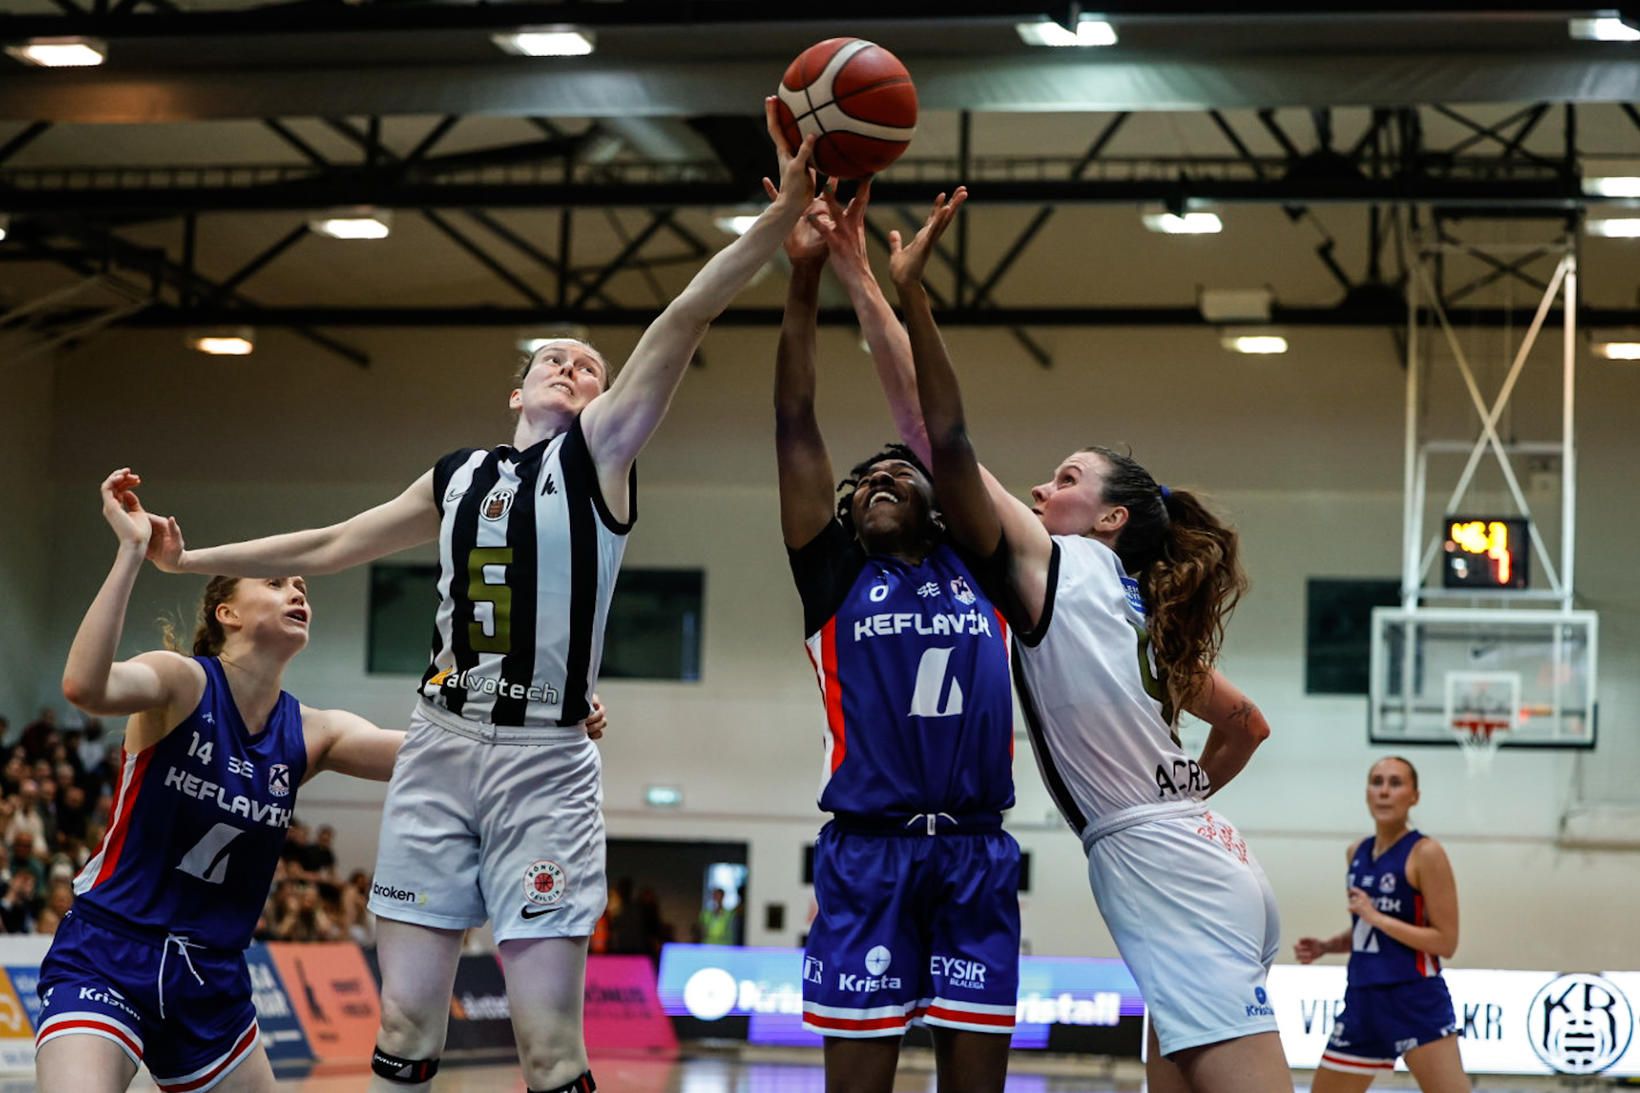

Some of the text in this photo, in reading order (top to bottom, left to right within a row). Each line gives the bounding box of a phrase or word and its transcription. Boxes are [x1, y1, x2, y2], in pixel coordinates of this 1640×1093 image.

[467, 548, 513, 655] 5
[446, 669, 558, 704] alvotech
[187, 731, 214, 766] 14
[164, 765, 292, 828] KEFLAVÍK
[373, 881, 416, 903] broken
[1464, 1003, 1502, 1040] KR
